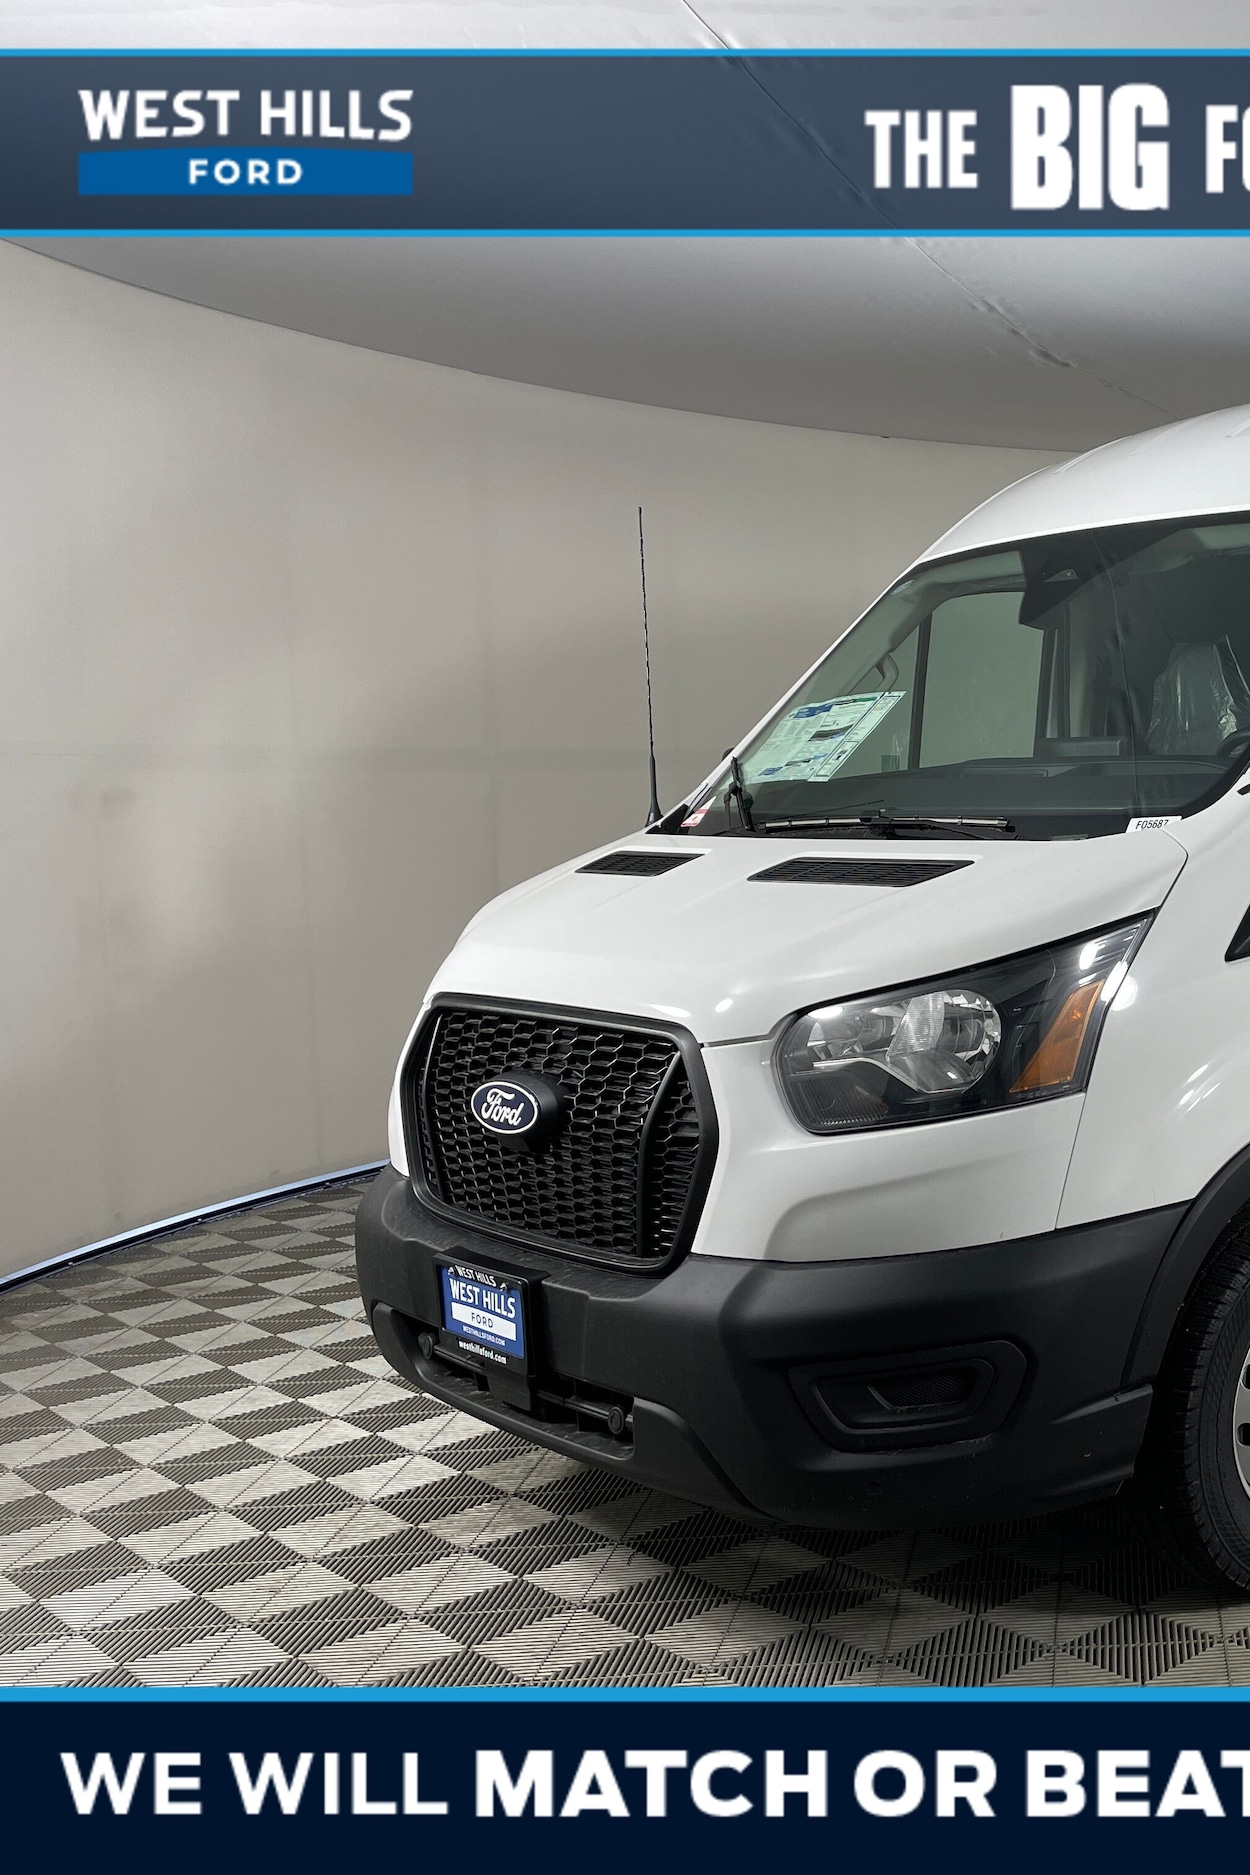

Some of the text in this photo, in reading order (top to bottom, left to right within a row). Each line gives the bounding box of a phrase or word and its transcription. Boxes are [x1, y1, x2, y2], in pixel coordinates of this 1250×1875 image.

[481, 1088, 525, 1126] Ford
[455, 1265, 498, 1287] WEST HILLS
[449, 1278, 516, 1319] WEST HILLS
[471, 1312, 494, 1329] FORD
